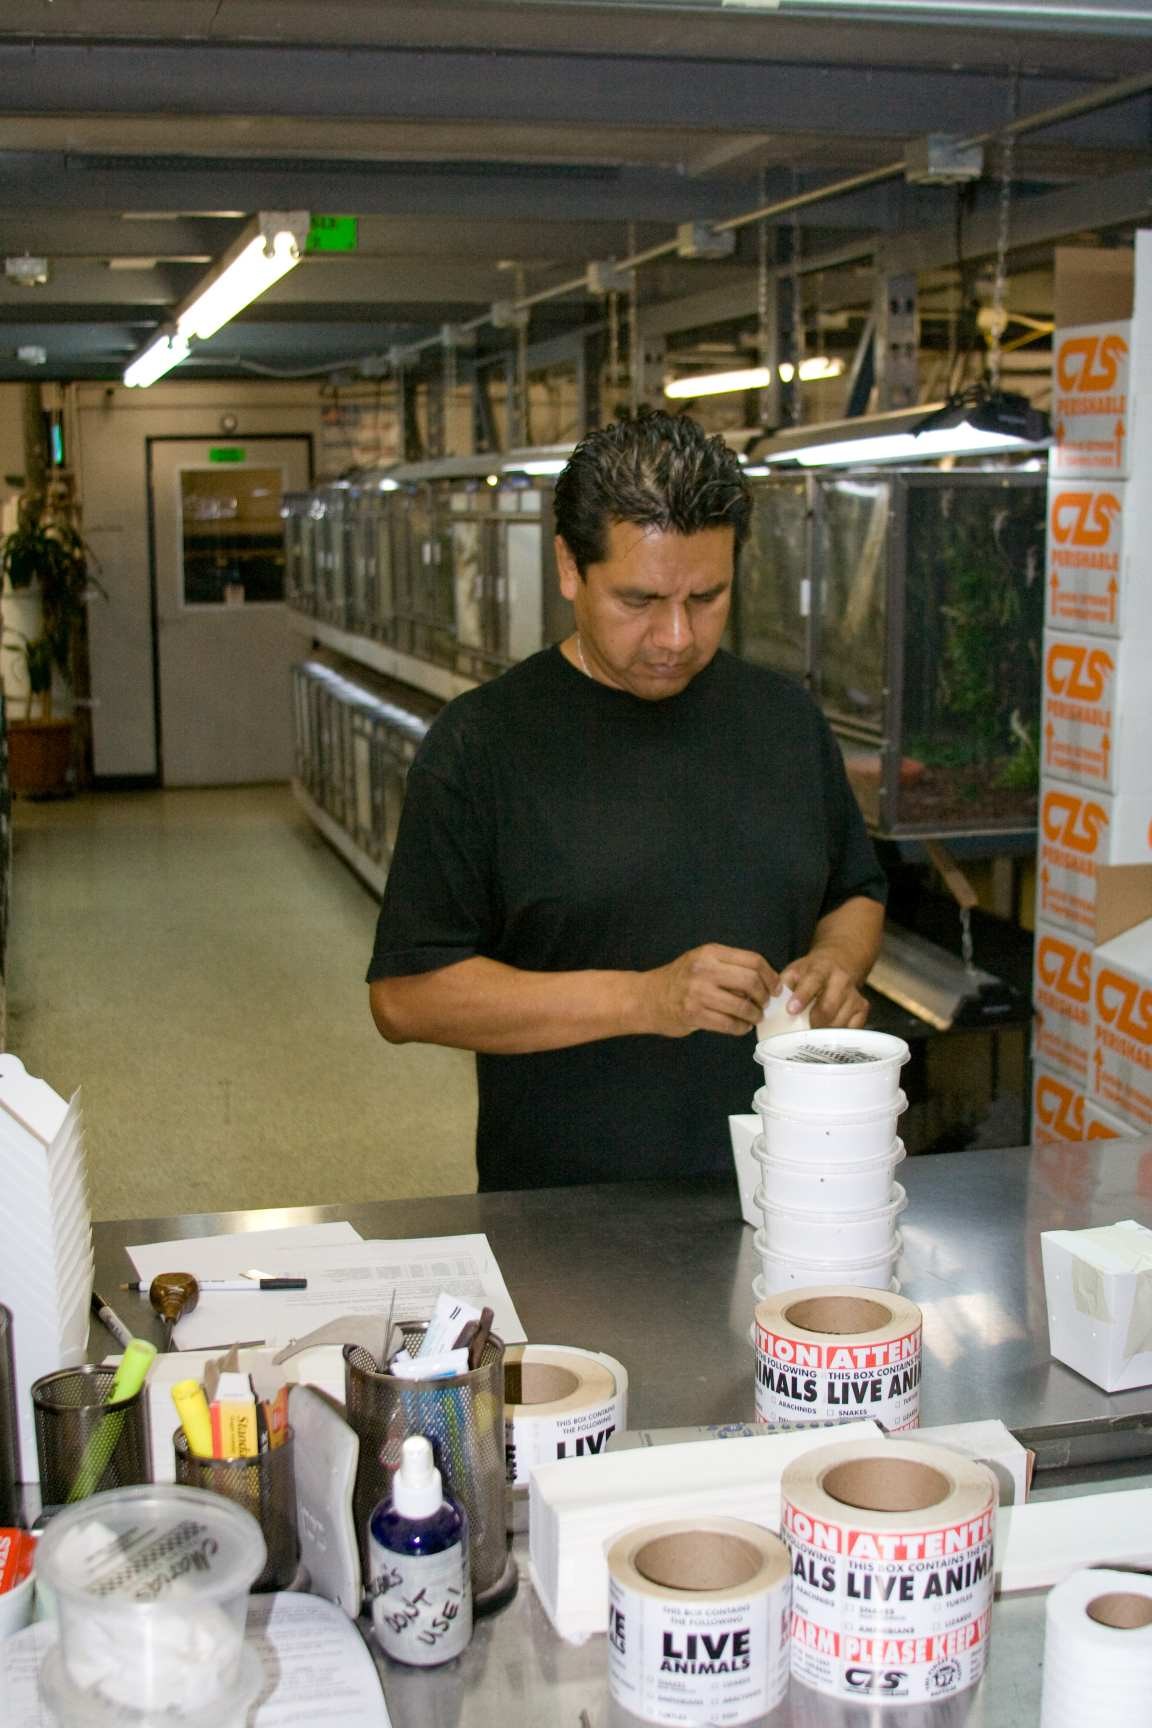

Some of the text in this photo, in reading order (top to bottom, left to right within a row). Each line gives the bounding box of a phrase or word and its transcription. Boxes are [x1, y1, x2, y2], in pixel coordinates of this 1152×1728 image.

[767, 1357, 817, 1379] FOLLOWING
[829, 1371, 850, 1380] THIS
[854, 1371, 875, 1380] BOX
[828, 1378, 882, 1405] LIVE
[779, 1400, 817, 1415] ARACHNIDS
[838, 1408, 868, 1417] SNAKES
[557, 1418, 572, 1428] THIS
[574, 1414, 587, 1425] BOX
[563, 1426, 576, 1435] THE
[849, 1560, 875, 1572] THIS
[908, 1554, 964, 1574] CONTAINS
[792, 1552, 836, 1593] ALS
[847, 1571, 914, 1601] LIVE
[663, 1627, 750, 1660] LIVE
[660, 1656, 750, 1675] ANIMALS
